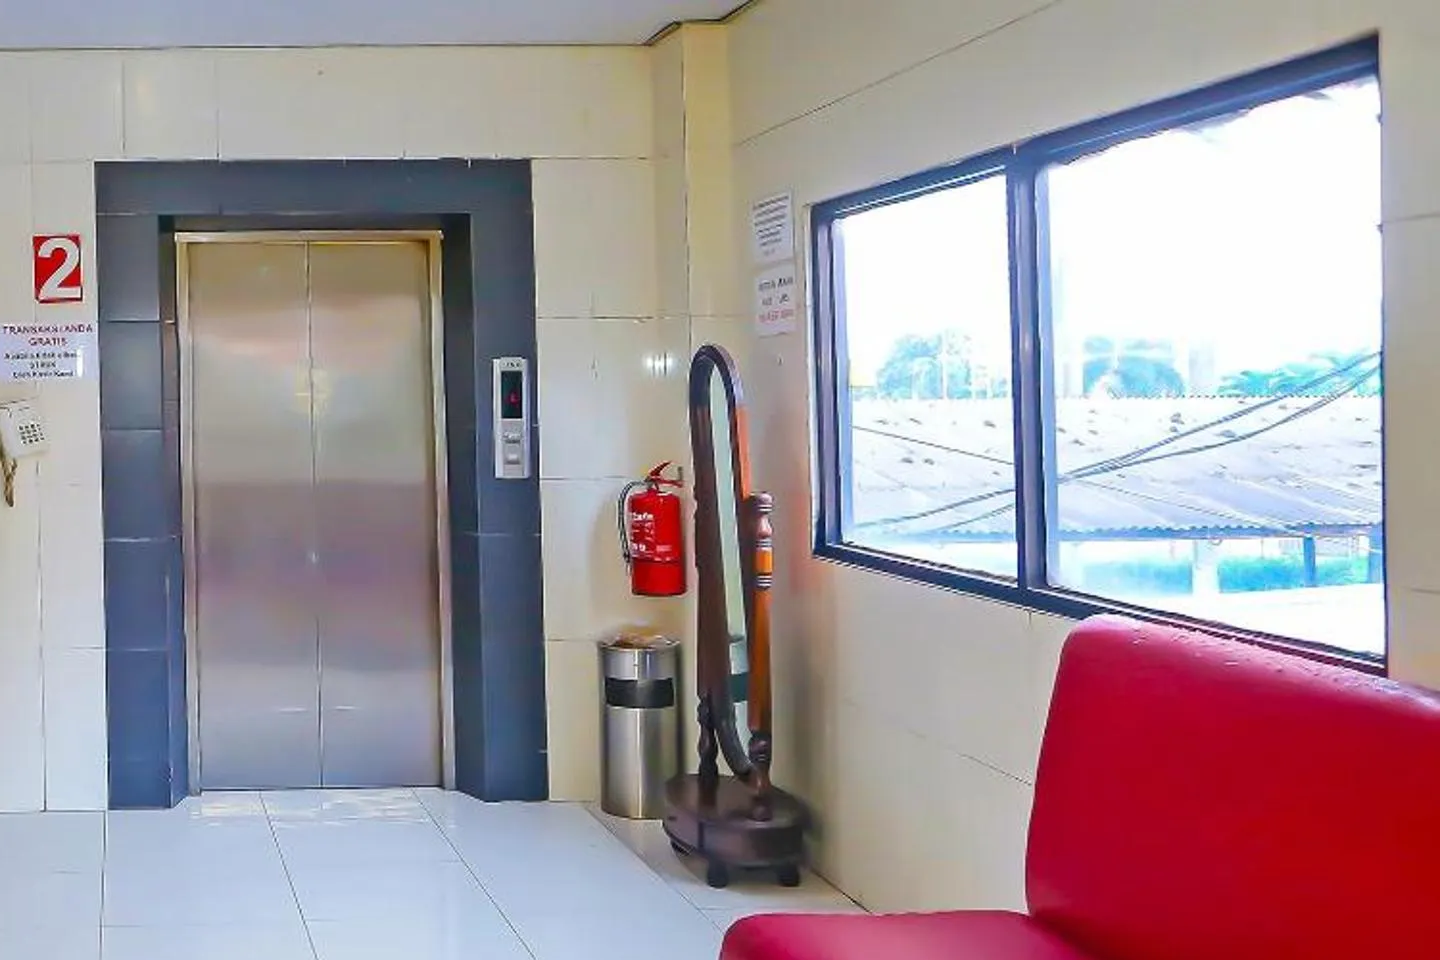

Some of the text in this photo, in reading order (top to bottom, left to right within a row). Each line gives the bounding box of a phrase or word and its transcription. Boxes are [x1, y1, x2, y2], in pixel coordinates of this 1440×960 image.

[38, 237, 83, 300] 2
[63, 323, 93, 333] ANDA
[28, 337, 68, 346] GRATIS
